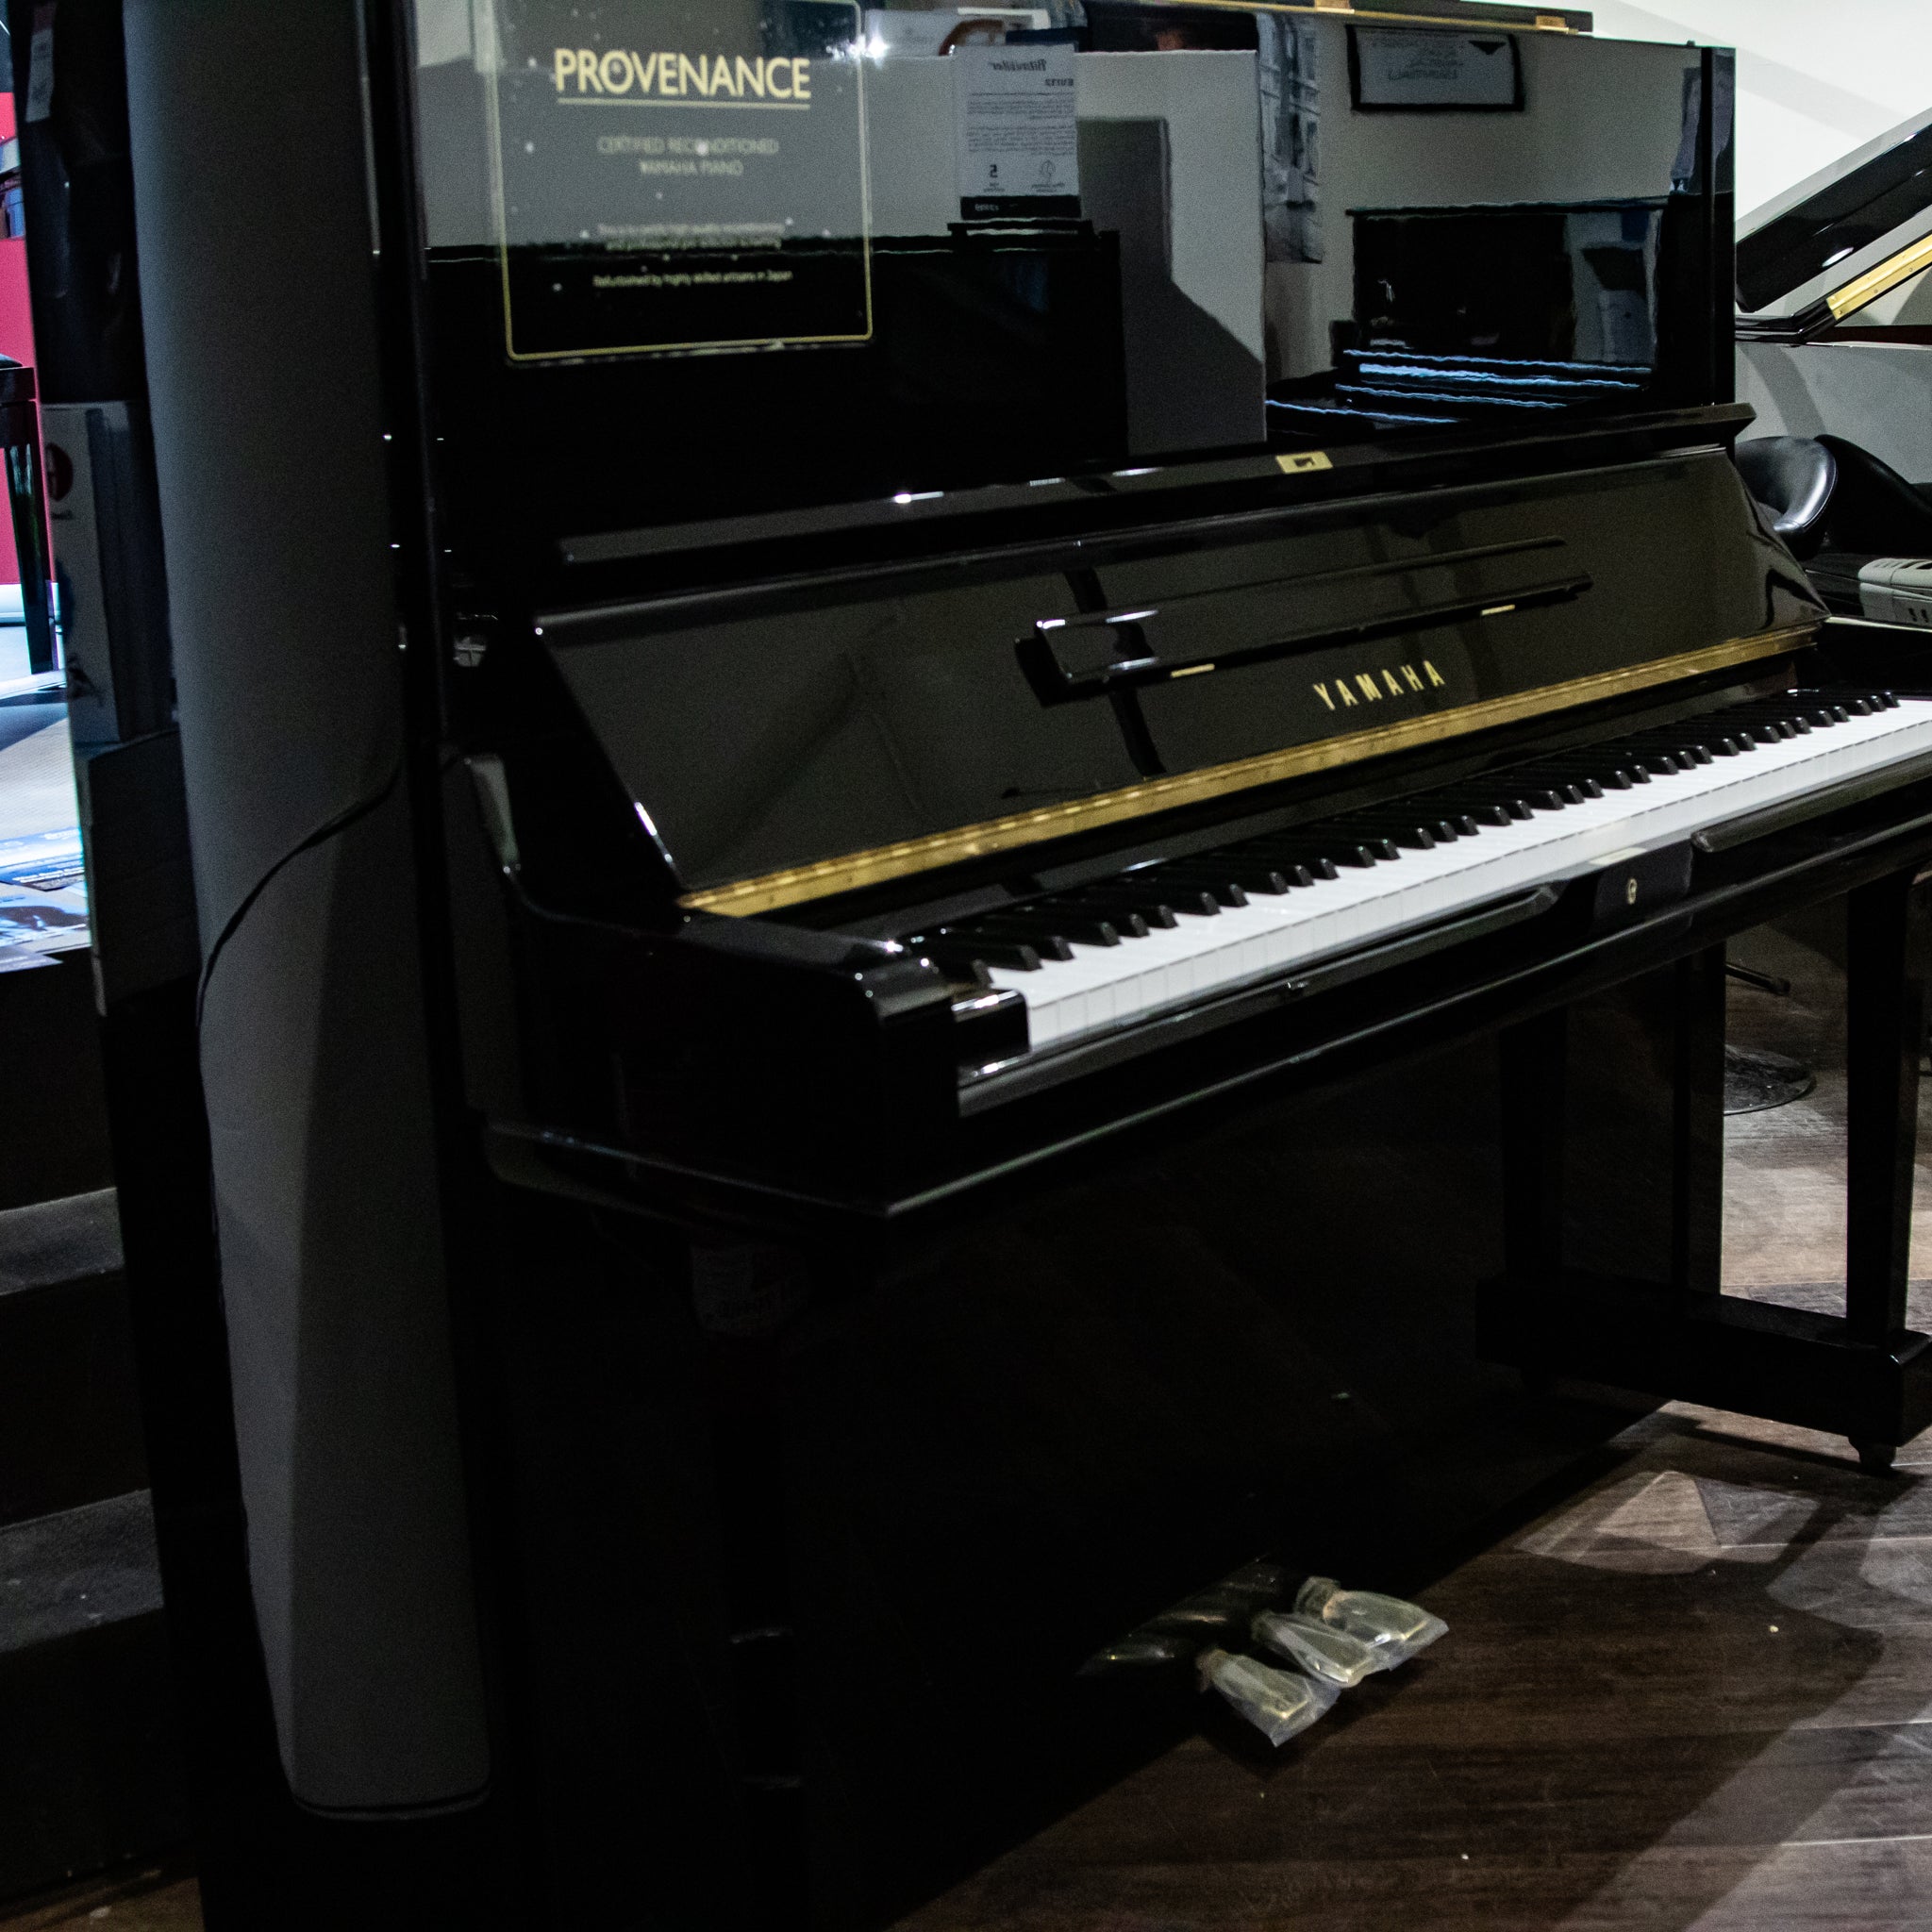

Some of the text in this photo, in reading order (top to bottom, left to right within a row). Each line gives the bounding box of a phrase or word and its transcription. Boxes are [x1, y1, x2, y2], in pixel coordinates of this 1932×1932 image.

[555, 48, 811, 99] PROVENANCE
[596, 136, 780, 156] CERTIFIED RECONDITIONED
[1312, 660, 1445, 710] YAMAHA
